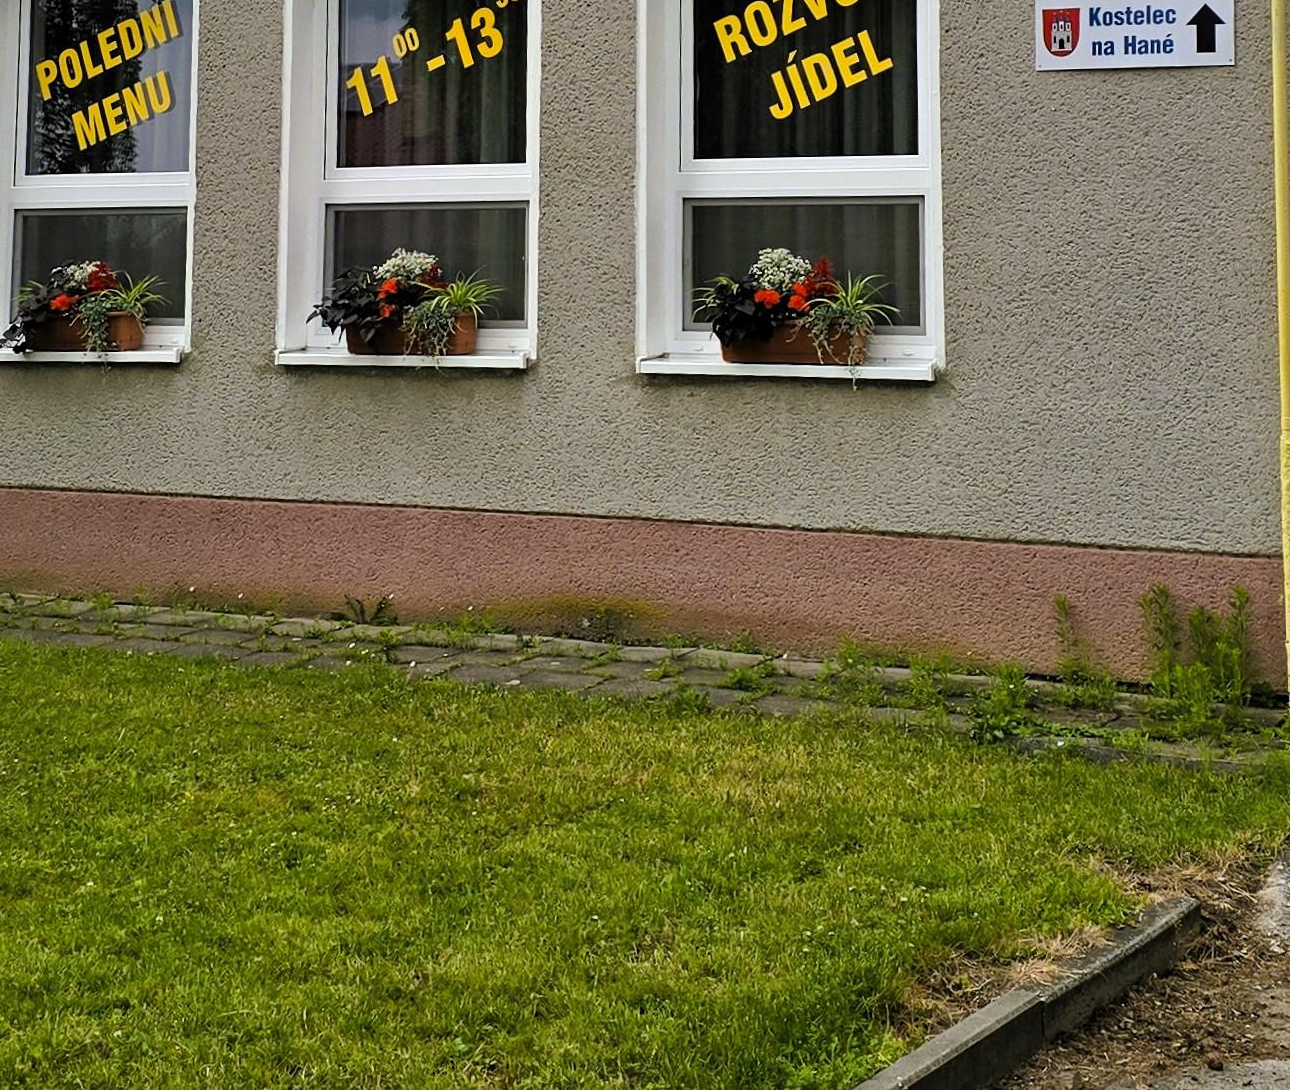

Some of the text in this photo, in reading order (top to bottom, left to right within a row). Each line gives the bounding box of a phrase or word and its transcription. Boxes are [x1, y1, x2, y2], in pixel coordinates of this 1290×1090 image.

[1088, 5, 1177, 27] Kostelec
[1091, 34, 1174, 56] na Hané
[769, 29, 894, 120] JÍDEL
[71, 70, 171, 151] MENU
